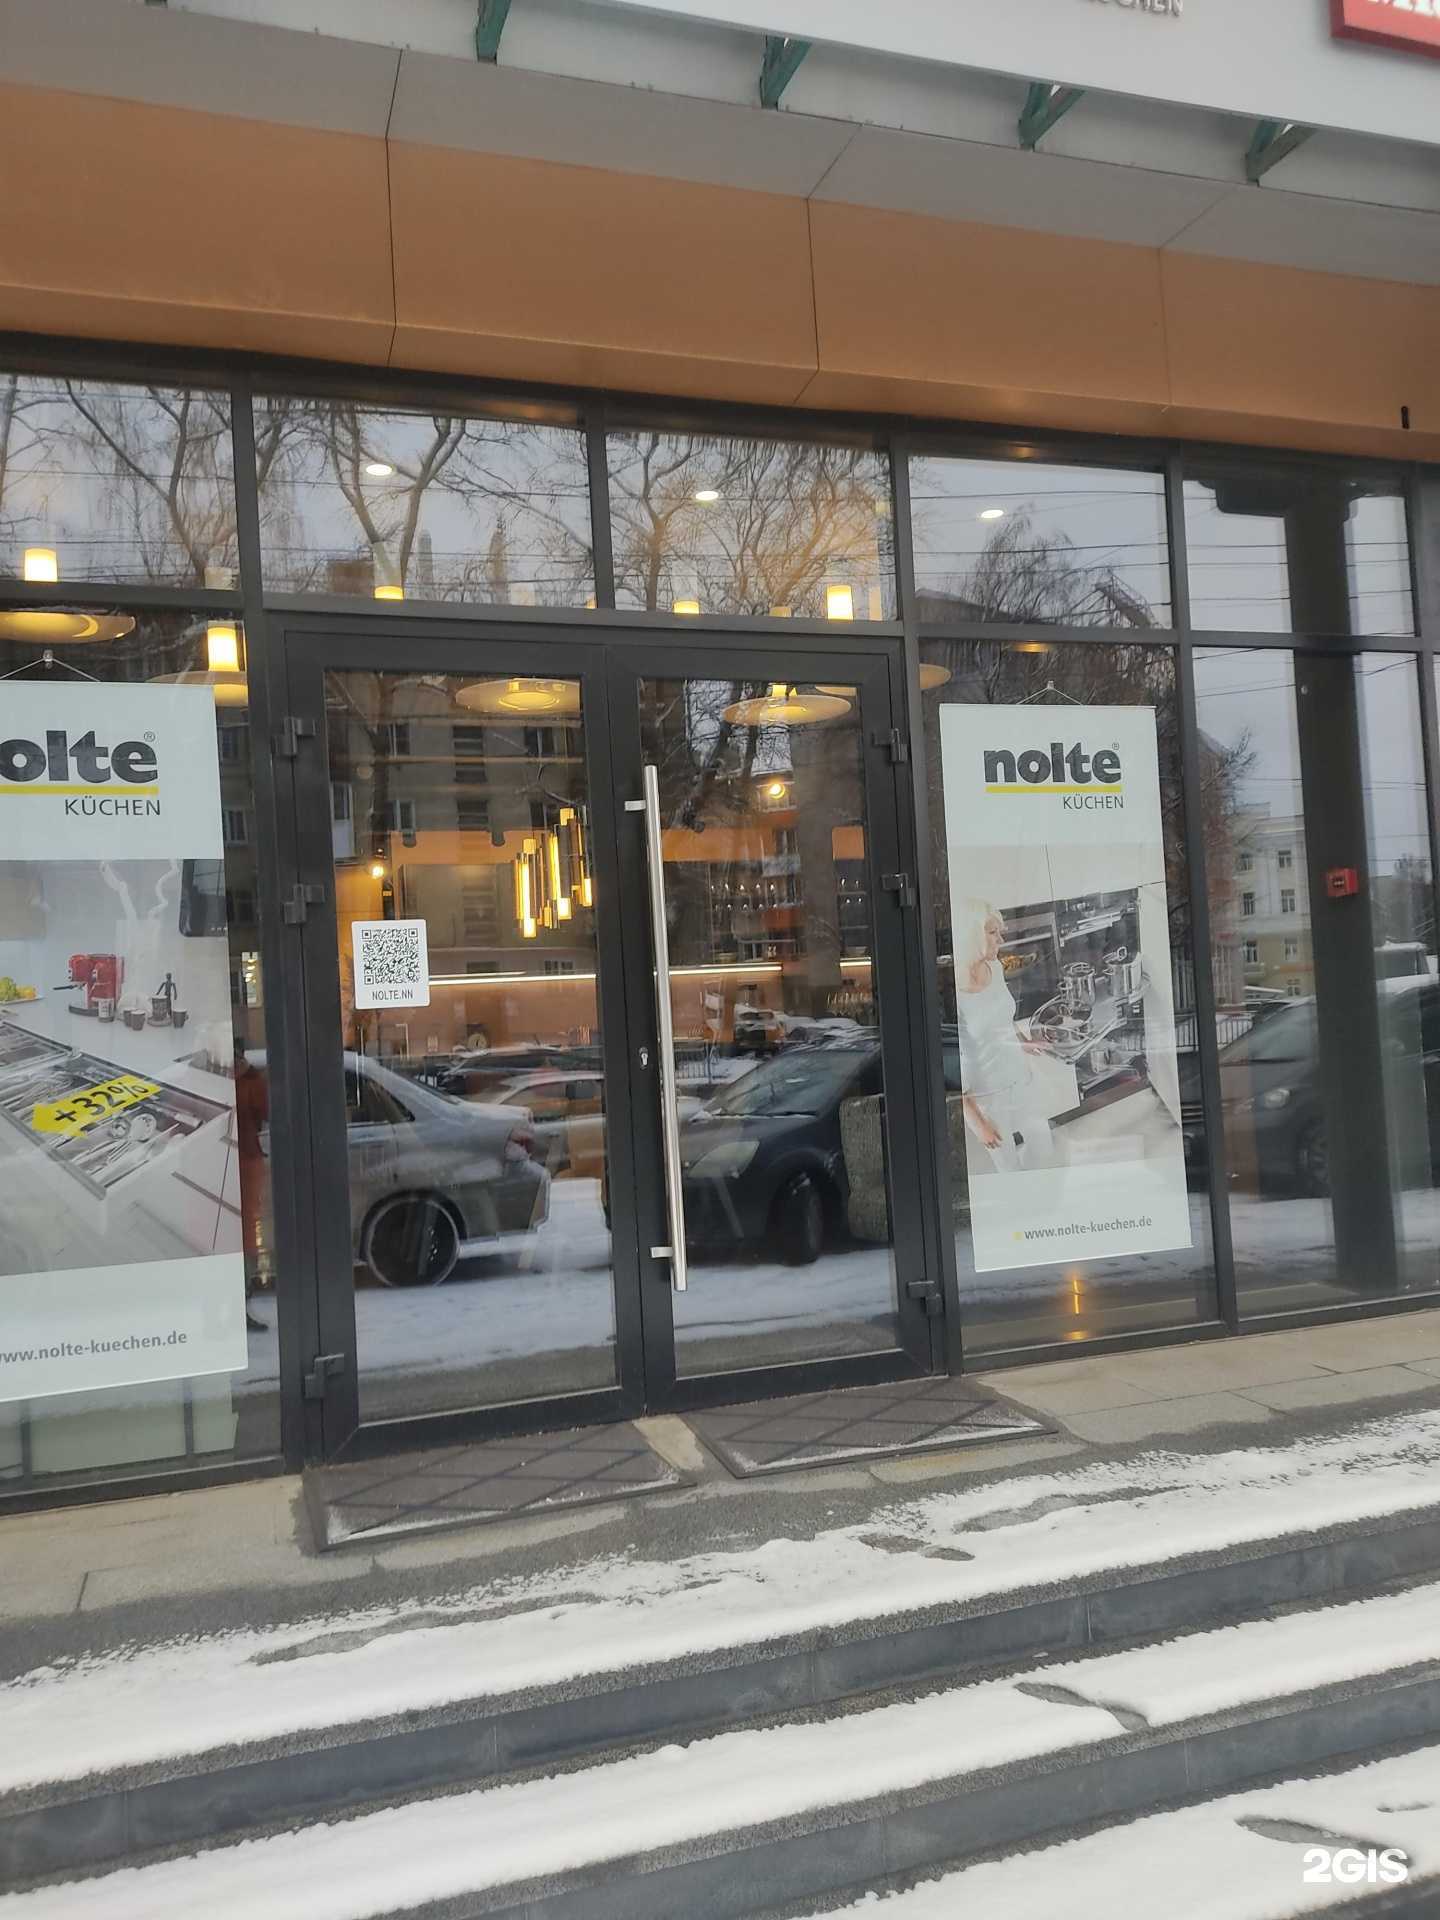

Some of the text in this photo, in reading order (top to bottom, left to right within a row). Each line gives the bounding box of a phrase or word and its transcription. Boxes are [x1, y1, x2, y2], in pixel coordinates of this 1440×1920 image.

[65, 795, 161, 816] KÜCHEN
[1063, 793, 1124, 810] KÜCHEN
[372, 989, 414, 1001] NOLTE.NN
[54, 1081, 149, 1123] +32%
[1024, 1215, 1153, 1240] www.nolte-kuechen.de
[0, 1330, 188, 1364] ww.nolte-kuechen.de
